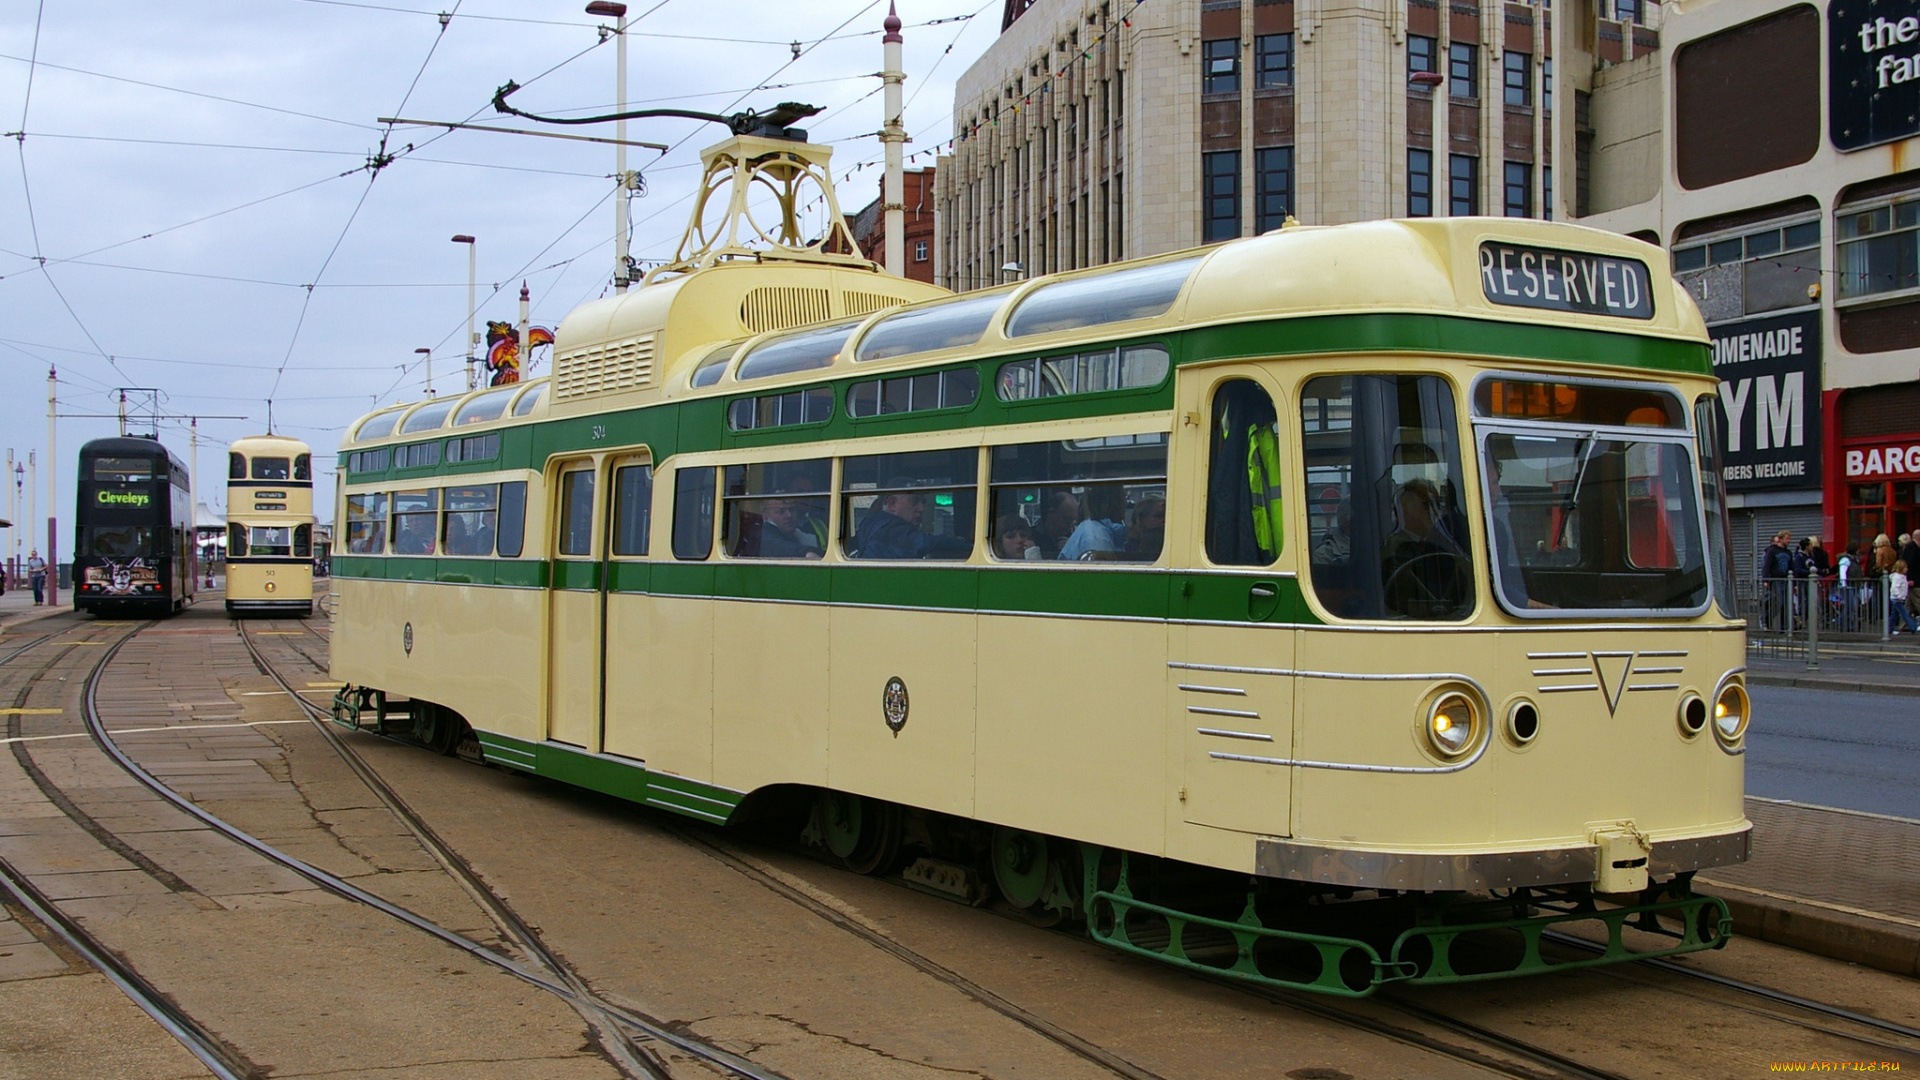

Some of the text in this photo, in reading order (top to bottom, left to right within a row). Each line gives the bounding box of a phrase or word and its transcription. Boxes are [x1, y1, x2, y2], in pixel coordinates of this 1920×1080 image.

[1857, 17, 1920, 53] the
[1479, 246, 1640, 310] RESERVED
[1755, 461, 1805, 479] WELCOME
[98, 490, 150, 507] Cleveleys
